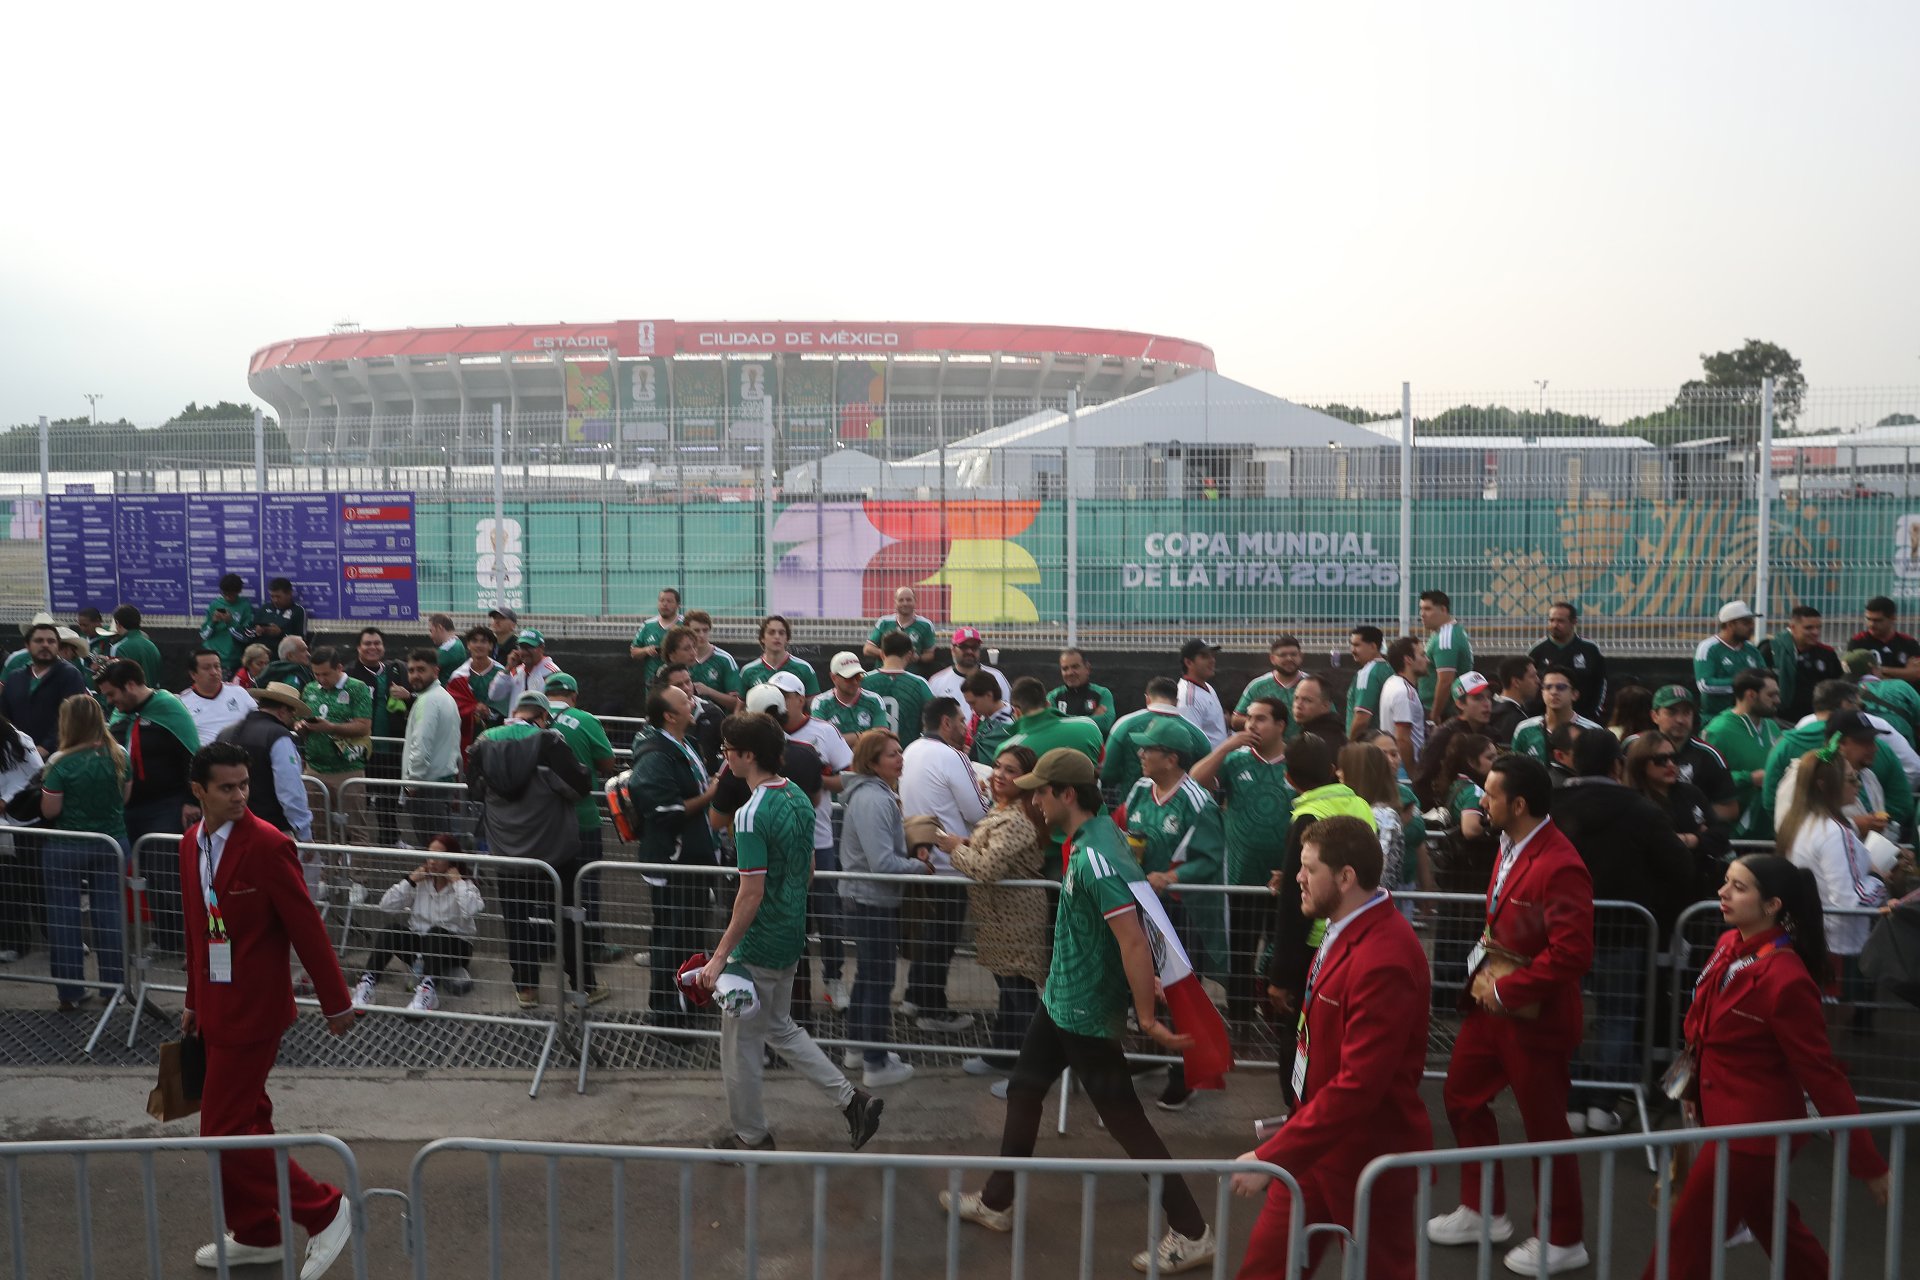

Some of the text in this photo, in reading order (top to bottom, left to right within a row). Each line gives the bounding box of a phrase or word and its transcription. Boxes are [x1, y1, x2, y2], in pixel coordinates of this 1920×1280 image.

[533, 336, 608, 348] ESTADIO
[699, 329, 898, 346] CIUDAD DE MÉXICO
[1144, 531, 1380, 557] COPA MUNDIAL
[1123, 562, 1401, 588] DE LA FIFA 2026
[477, 590, 523, 598] WOR CUP
